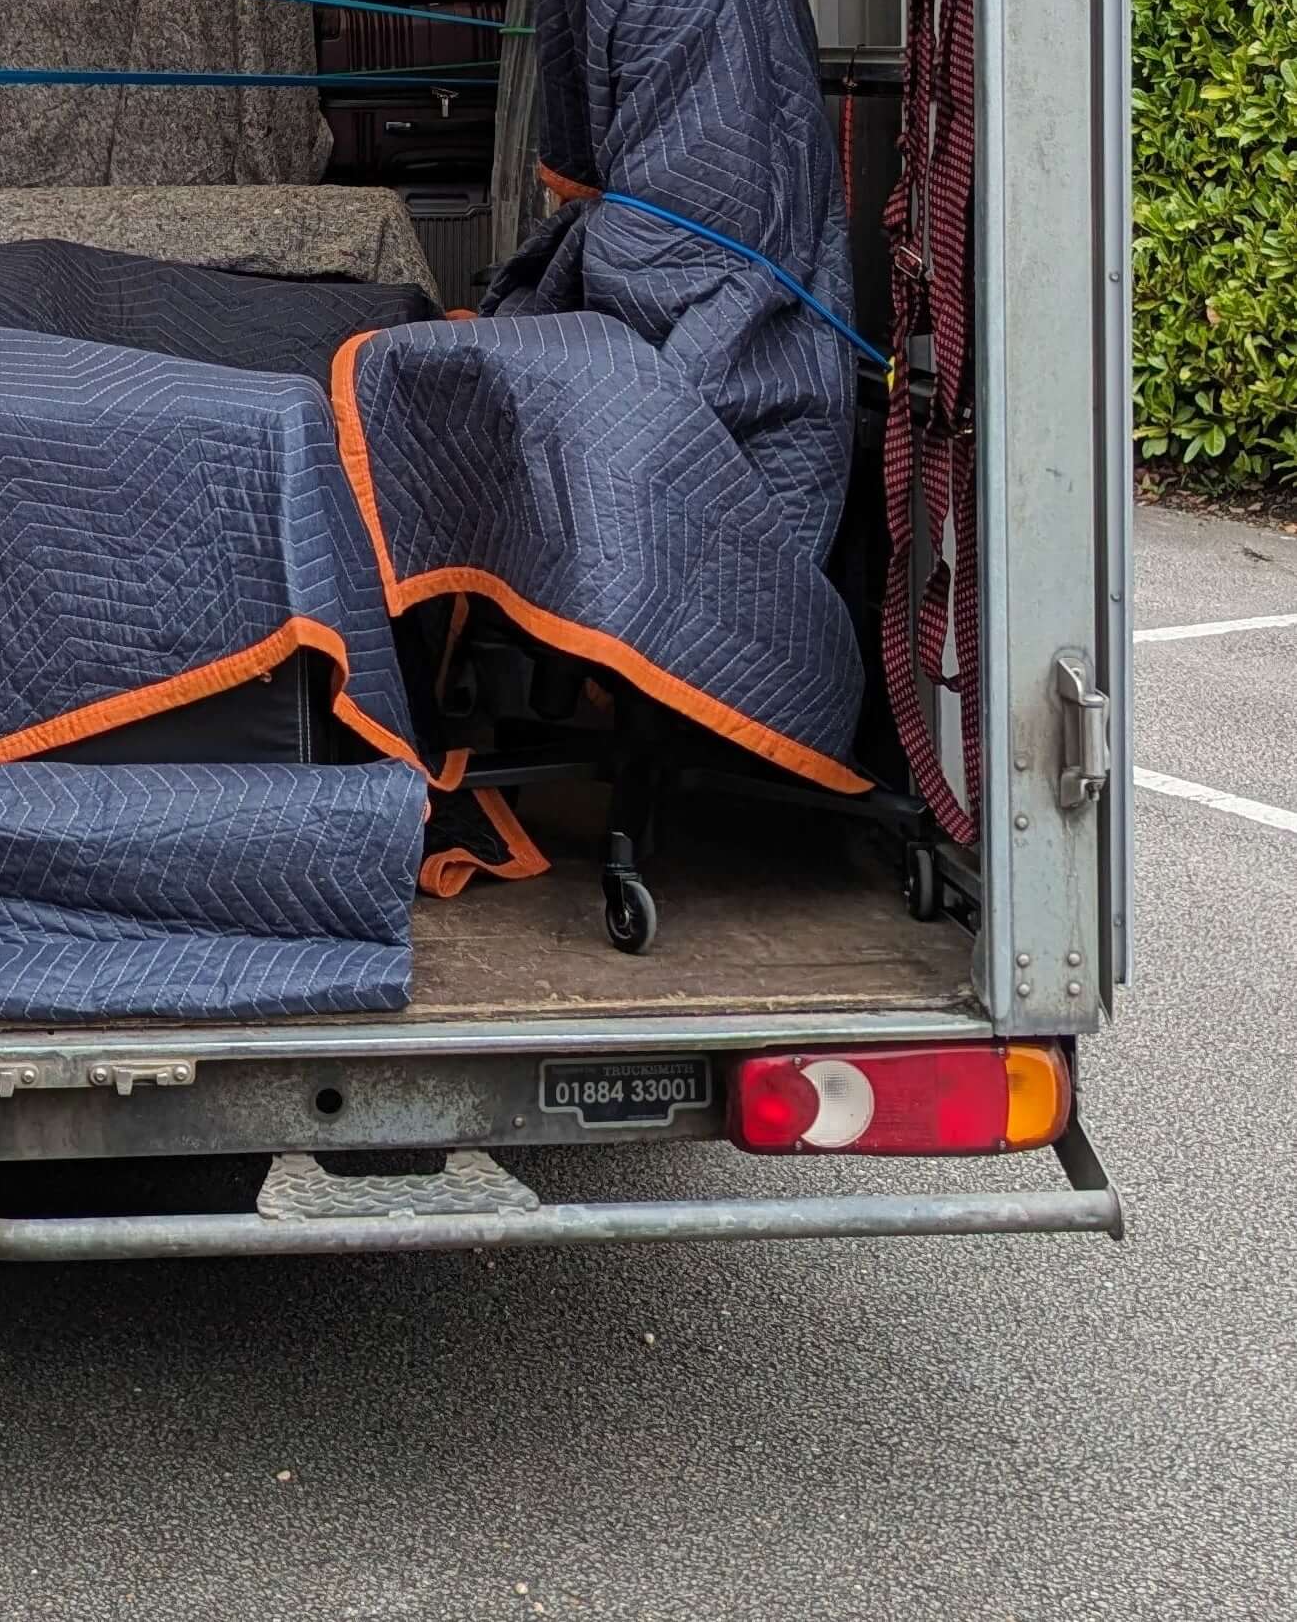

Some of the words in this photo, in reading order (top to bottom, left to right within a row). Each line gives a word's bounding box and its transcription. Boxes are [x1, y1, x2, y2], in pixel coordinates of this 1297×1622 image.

[602, 1063, 695, 1077] TRUCKSMITH
[555, 1080, 624, 1104] 01884
[630, 1078, 696, 1102] 33001
